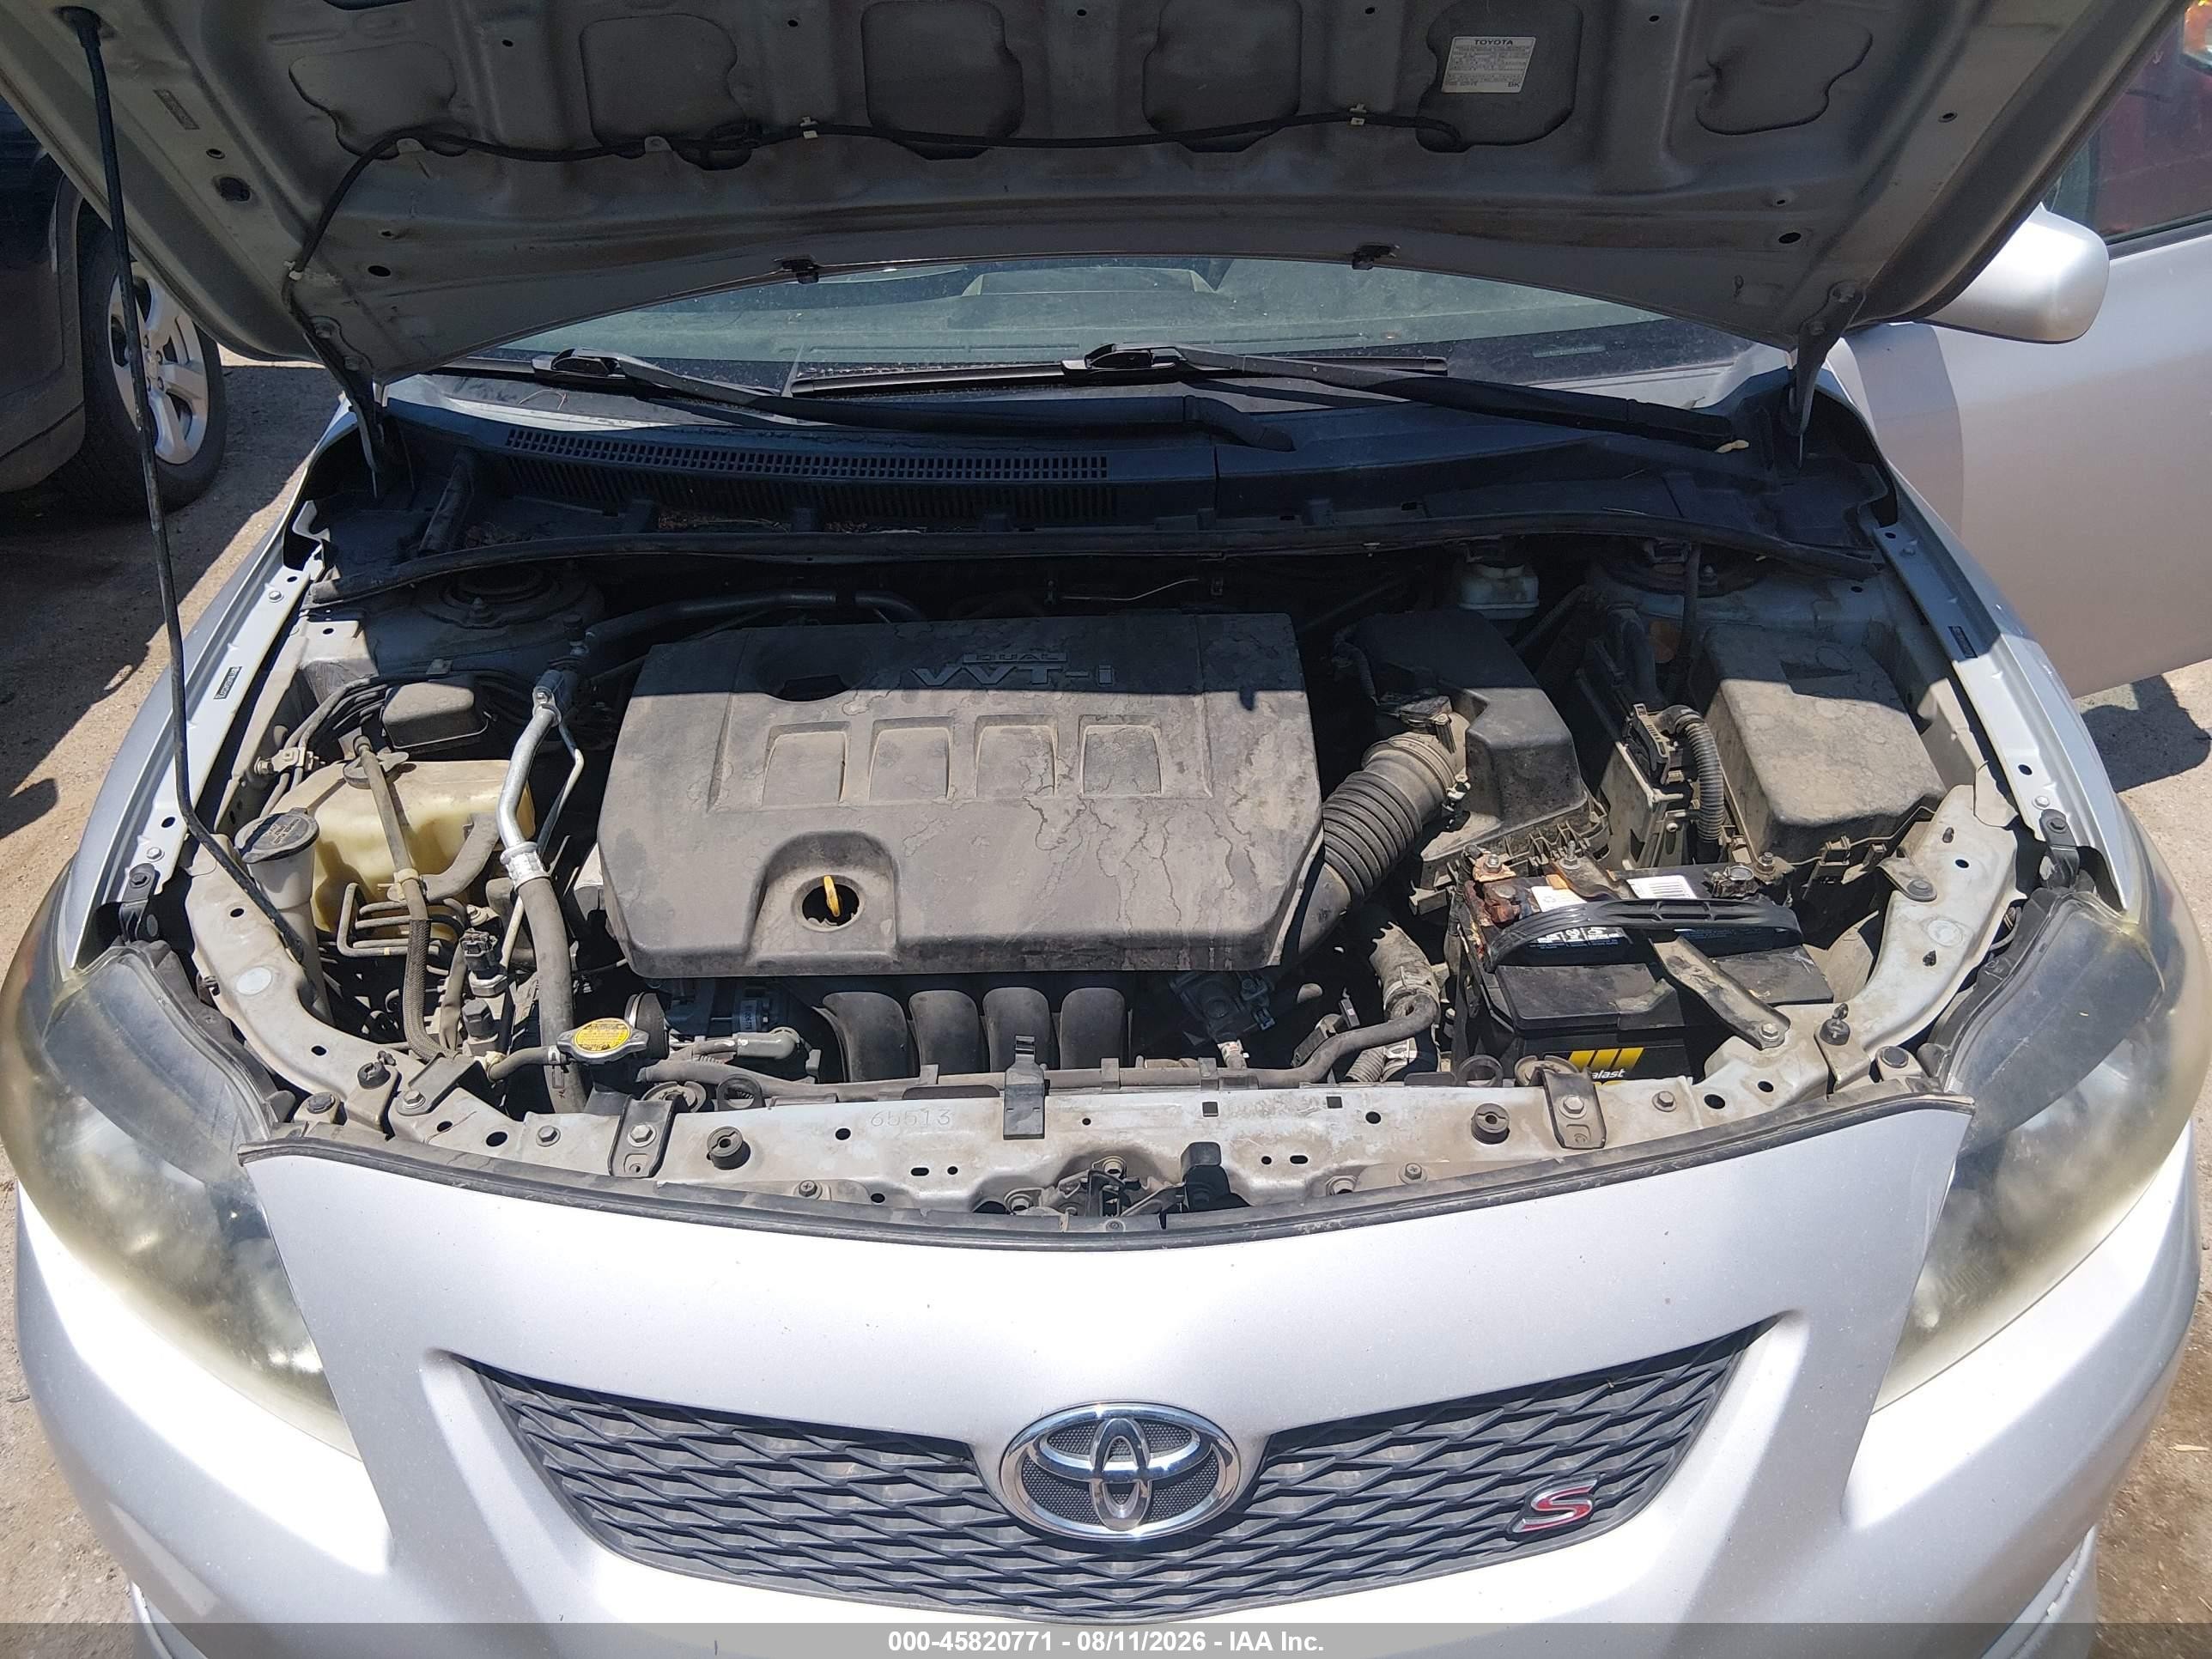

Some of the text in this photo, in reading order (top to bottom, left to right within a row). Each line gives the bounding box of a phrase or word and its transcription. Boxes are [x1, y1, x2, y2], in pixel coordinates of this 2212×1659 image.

[910, 665, 1114, 686] VVT-i
[1591, 1068, 1626, 1079] alast
[1512, 1479, 1597, 1533] S
